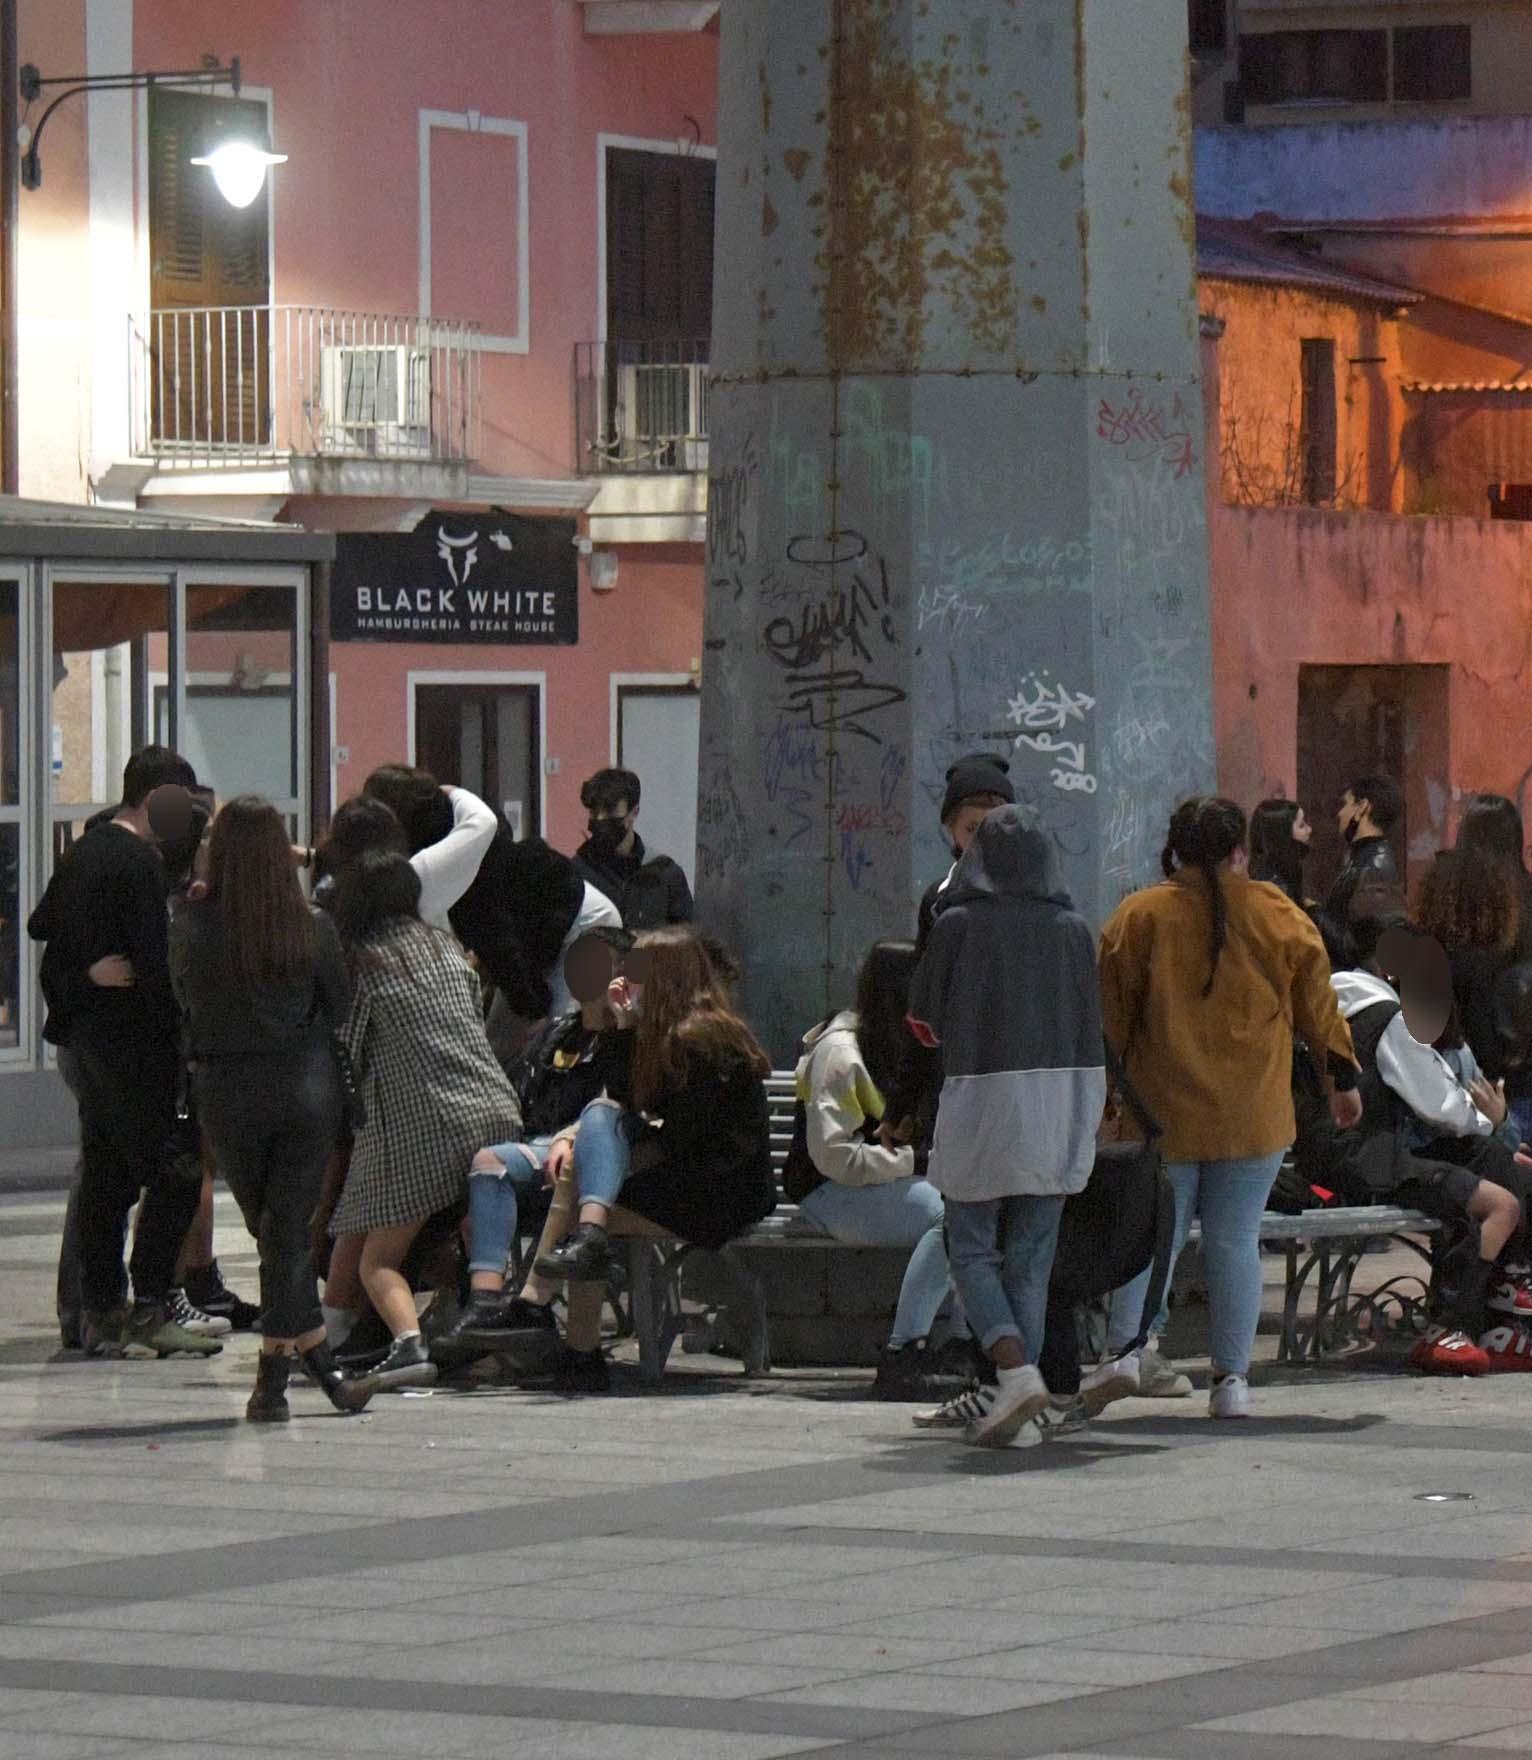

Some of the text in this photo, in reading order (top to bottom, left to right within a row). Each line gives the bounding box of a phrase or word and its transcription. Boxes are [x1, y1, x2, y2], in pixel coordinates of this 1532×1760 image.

[356, 586, 556, 616] BLACK WHITE
[357, 617, 556, 633] HAMBURGHERIA STEAK HOUSE
